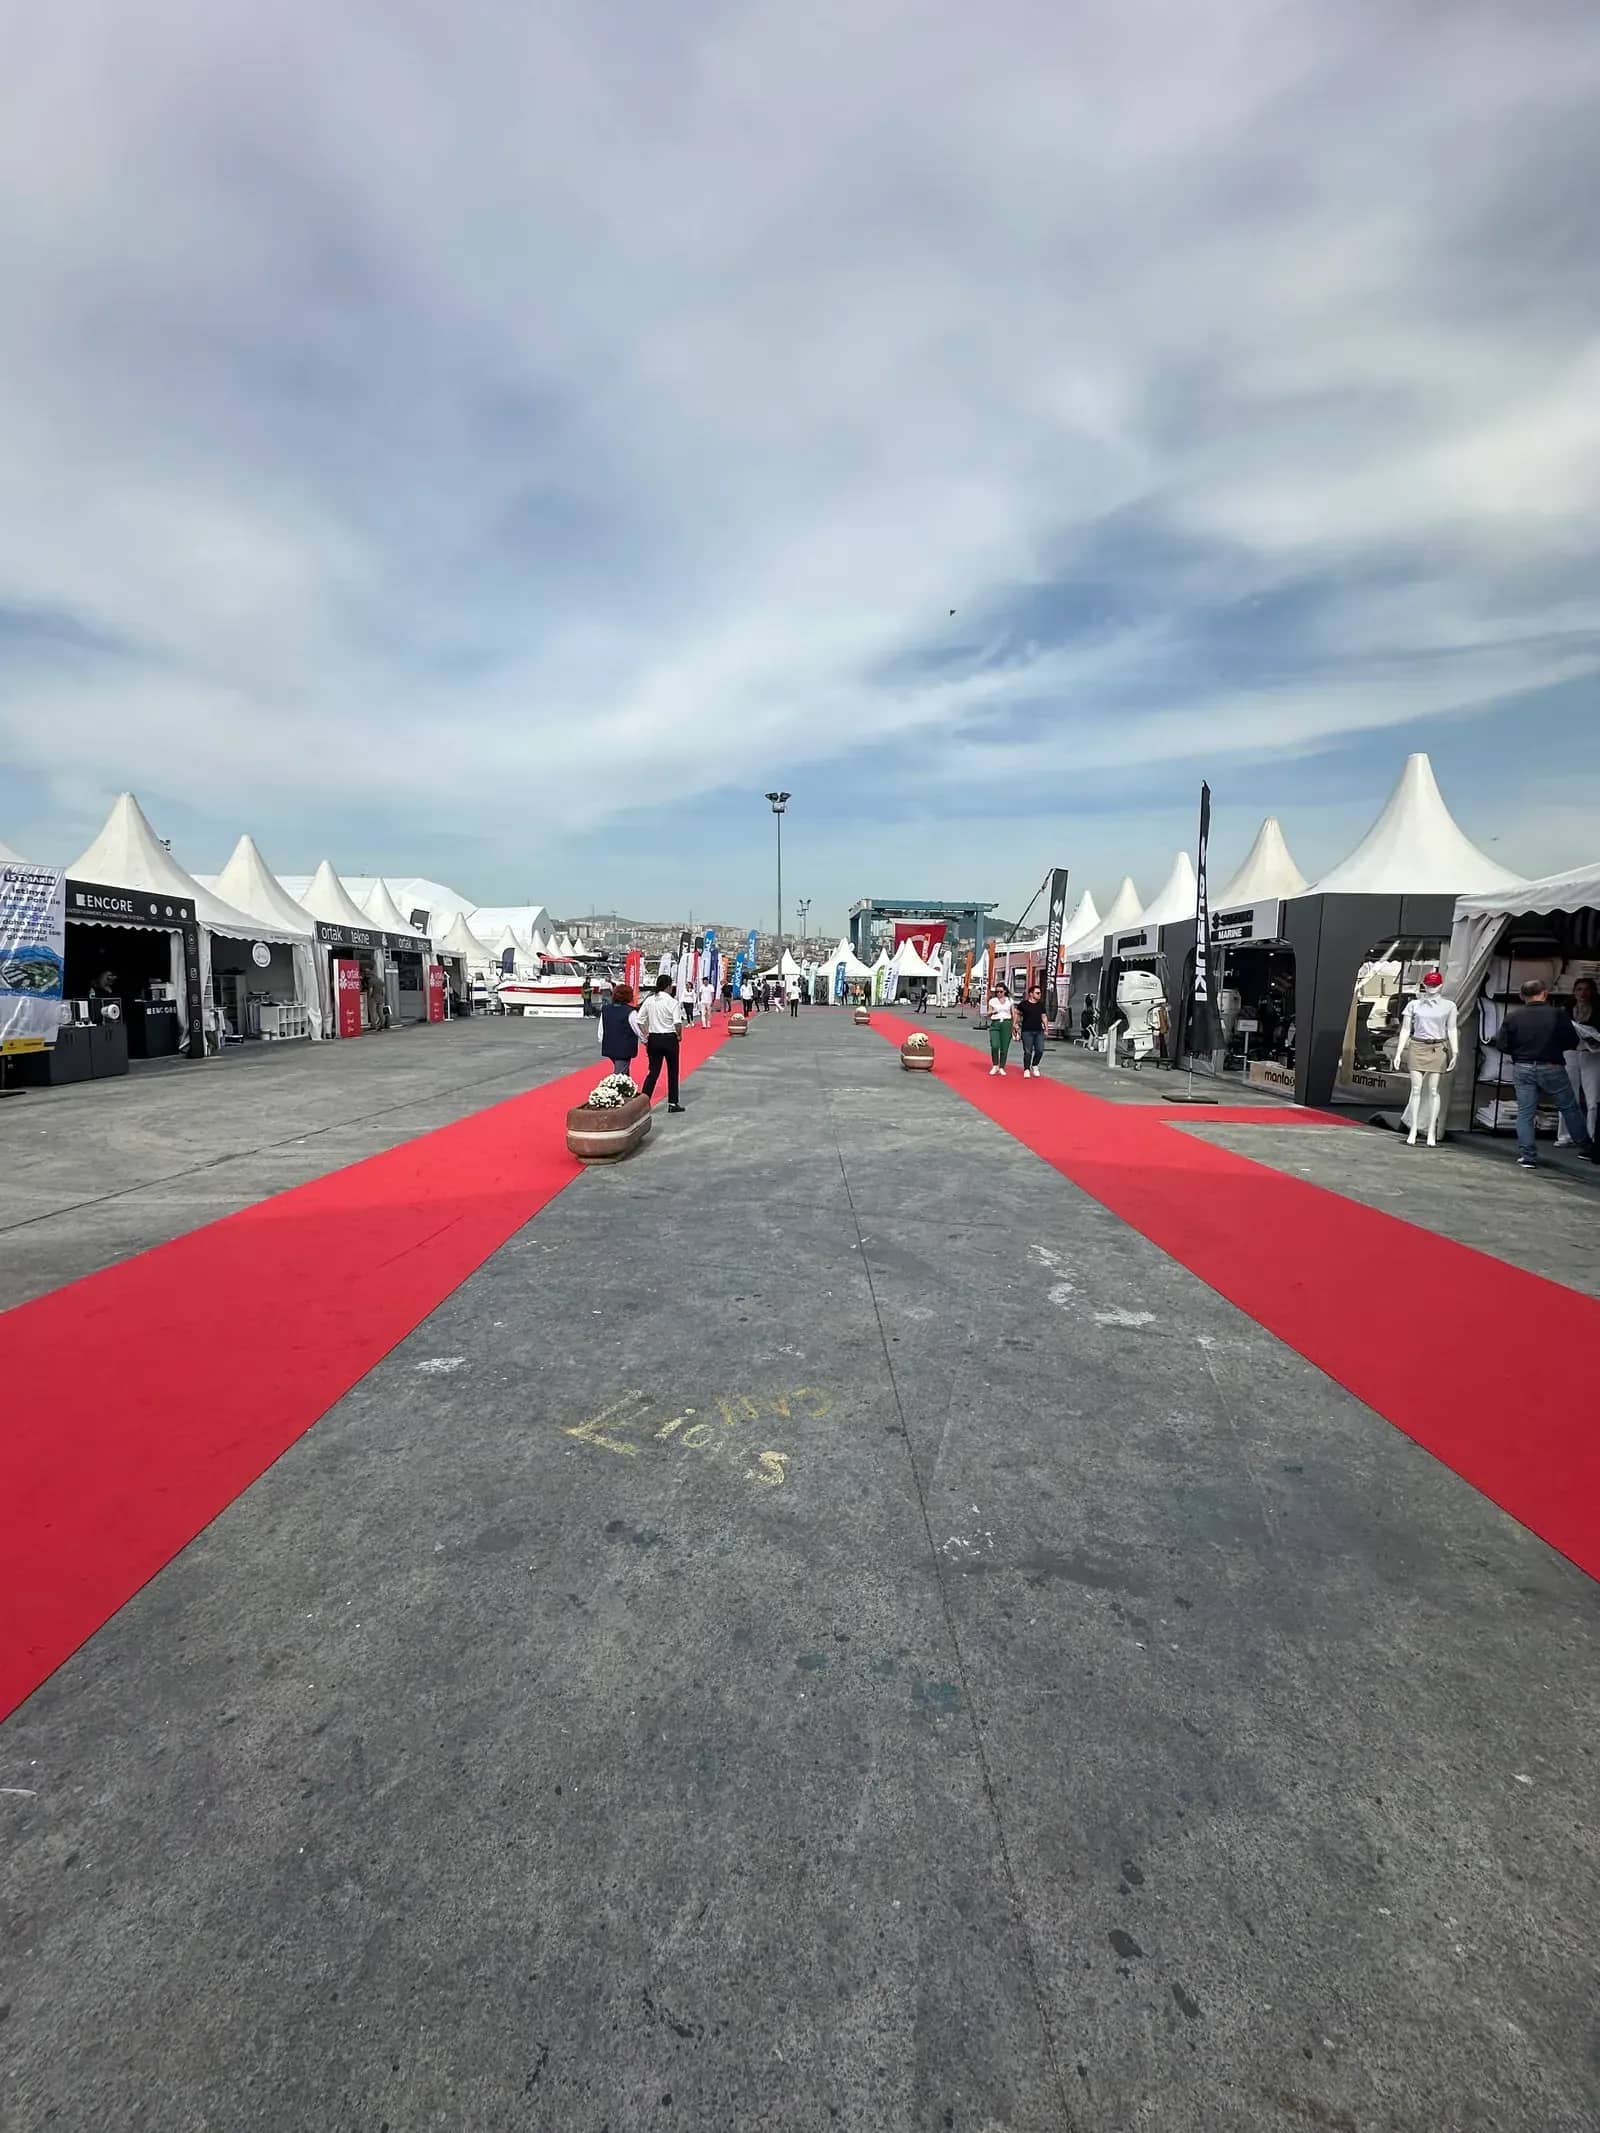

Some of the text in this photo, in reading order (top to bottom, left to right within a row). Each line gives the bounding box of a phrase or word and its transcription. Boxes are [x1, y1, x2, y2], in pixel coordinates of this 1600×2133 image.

[87, 895, 133, 912] ENCORE
[321, 926, 370, 945] ortak tekne
[1218, 927, 1242, 940] MARINE
